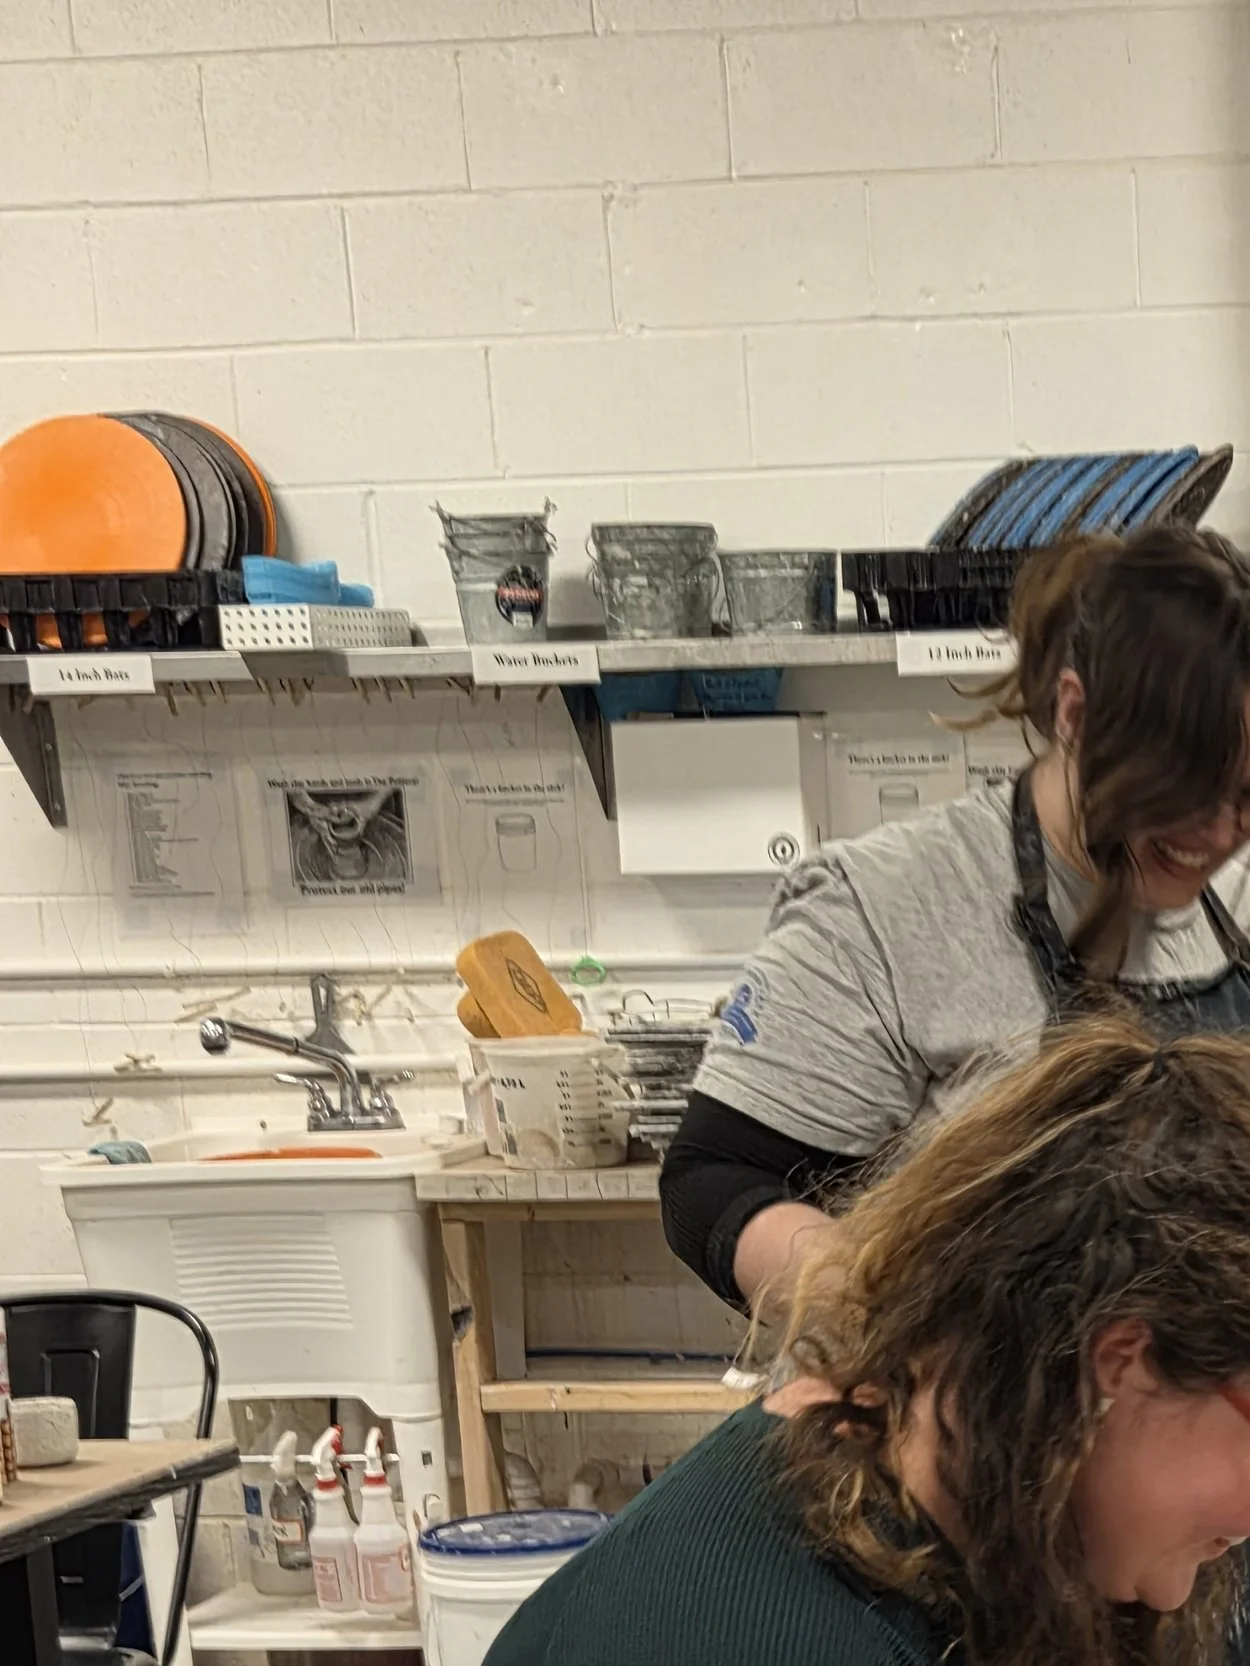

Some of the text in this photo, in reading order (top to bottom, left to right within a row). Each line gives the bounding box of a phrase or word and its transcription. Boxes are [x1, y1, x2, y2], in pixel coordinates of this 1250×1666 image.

[493, 651, 580, 667] Water Buckets
[945, 646, 972, 661] Inch
[75, 667, 102, 681] Inch
